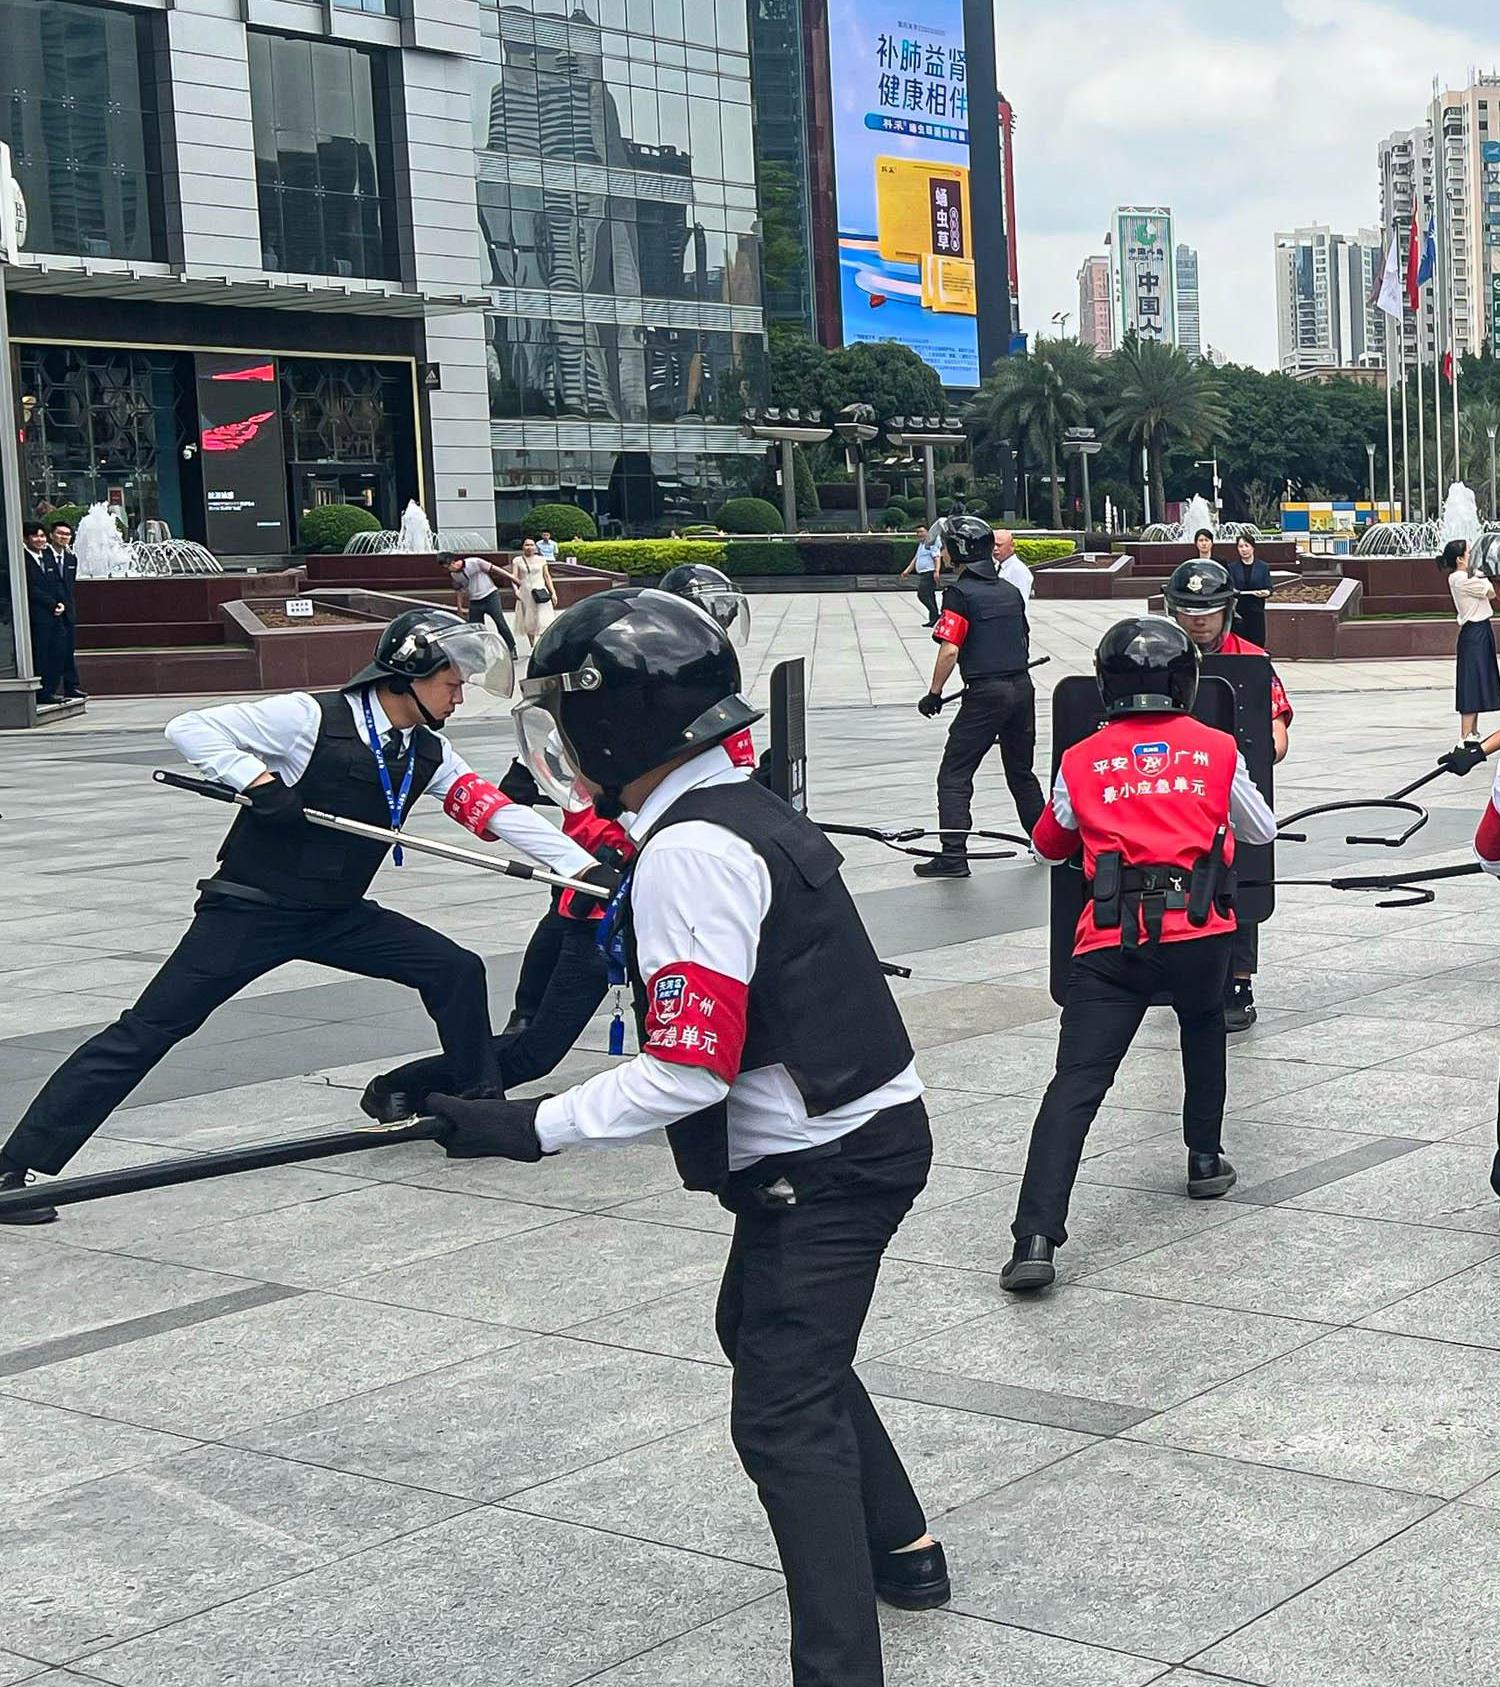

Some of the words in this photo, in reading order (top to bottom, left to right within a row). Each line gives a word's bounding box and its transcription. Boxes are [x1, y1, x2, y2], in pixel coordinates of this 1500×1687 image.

[876, 33, 966, 82] 补肺益肾
[878, 72, 966, 120] 健康相伴
[1138, 271, 1163, 342] 中国人
[1093, 756, 1128, 775] 平安
[1174, 750, 1209, 767] 广州
[1102, 776, 1206, 804] 最小应急单元
[687, 992, 716, 1017] 广州
